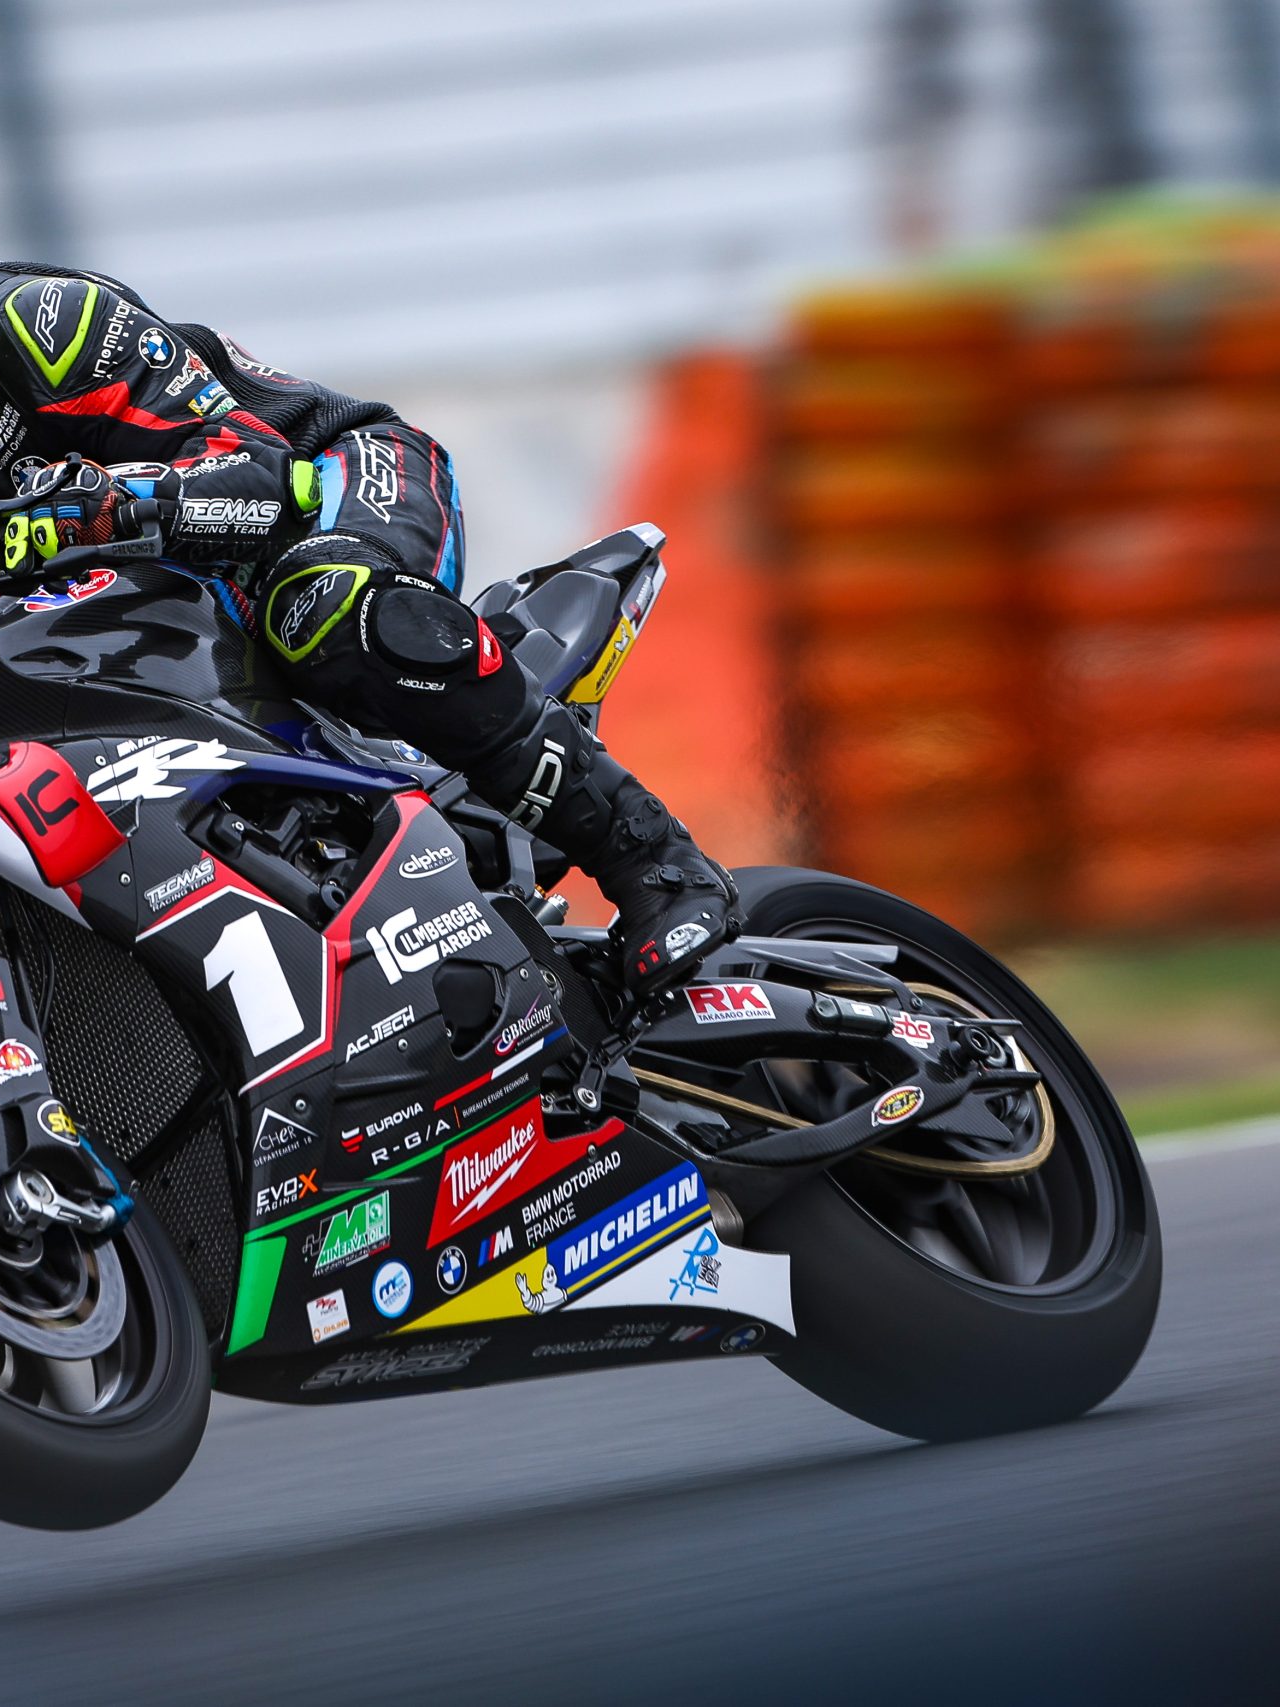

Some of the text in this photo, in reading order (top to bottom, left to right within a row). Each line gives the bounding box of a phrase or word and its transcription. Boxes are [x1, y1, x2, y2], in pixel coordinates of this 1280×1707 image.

[35, 278, 68, 353] RST
[351, 430, 398, 524] RST
[181, 497, 282, 527] TECMAS
[234, 525, 269, 535] TEAM
[281, 569, 348, 648] RST
[144, 857, 215, 904] TECMAS
[404, 845, 453, 873] alpha
[151, 874, 215, 912] RACING TEAM
[400, 901, 483, 953] ILMBERGER
[203, 910, 305, 1058] 1
[685, 983, 767, 1014] RK
[501, 1004, 552, 1045] GBRacing
[698, 1006, 772, 1023] TAKASAGO CHAIN
[365, 1102, 423, 1138] EUROVIA
[444, 1119, 535, 1207] Milwaukee
[256, 1194, 298, 1216] RACING
[521, 1150, 622, 1225] BMW MOTORRAD
[525, 1201, 577, 1248] FRANCE
[564, 1171, 698, 1276] MICHELIN
